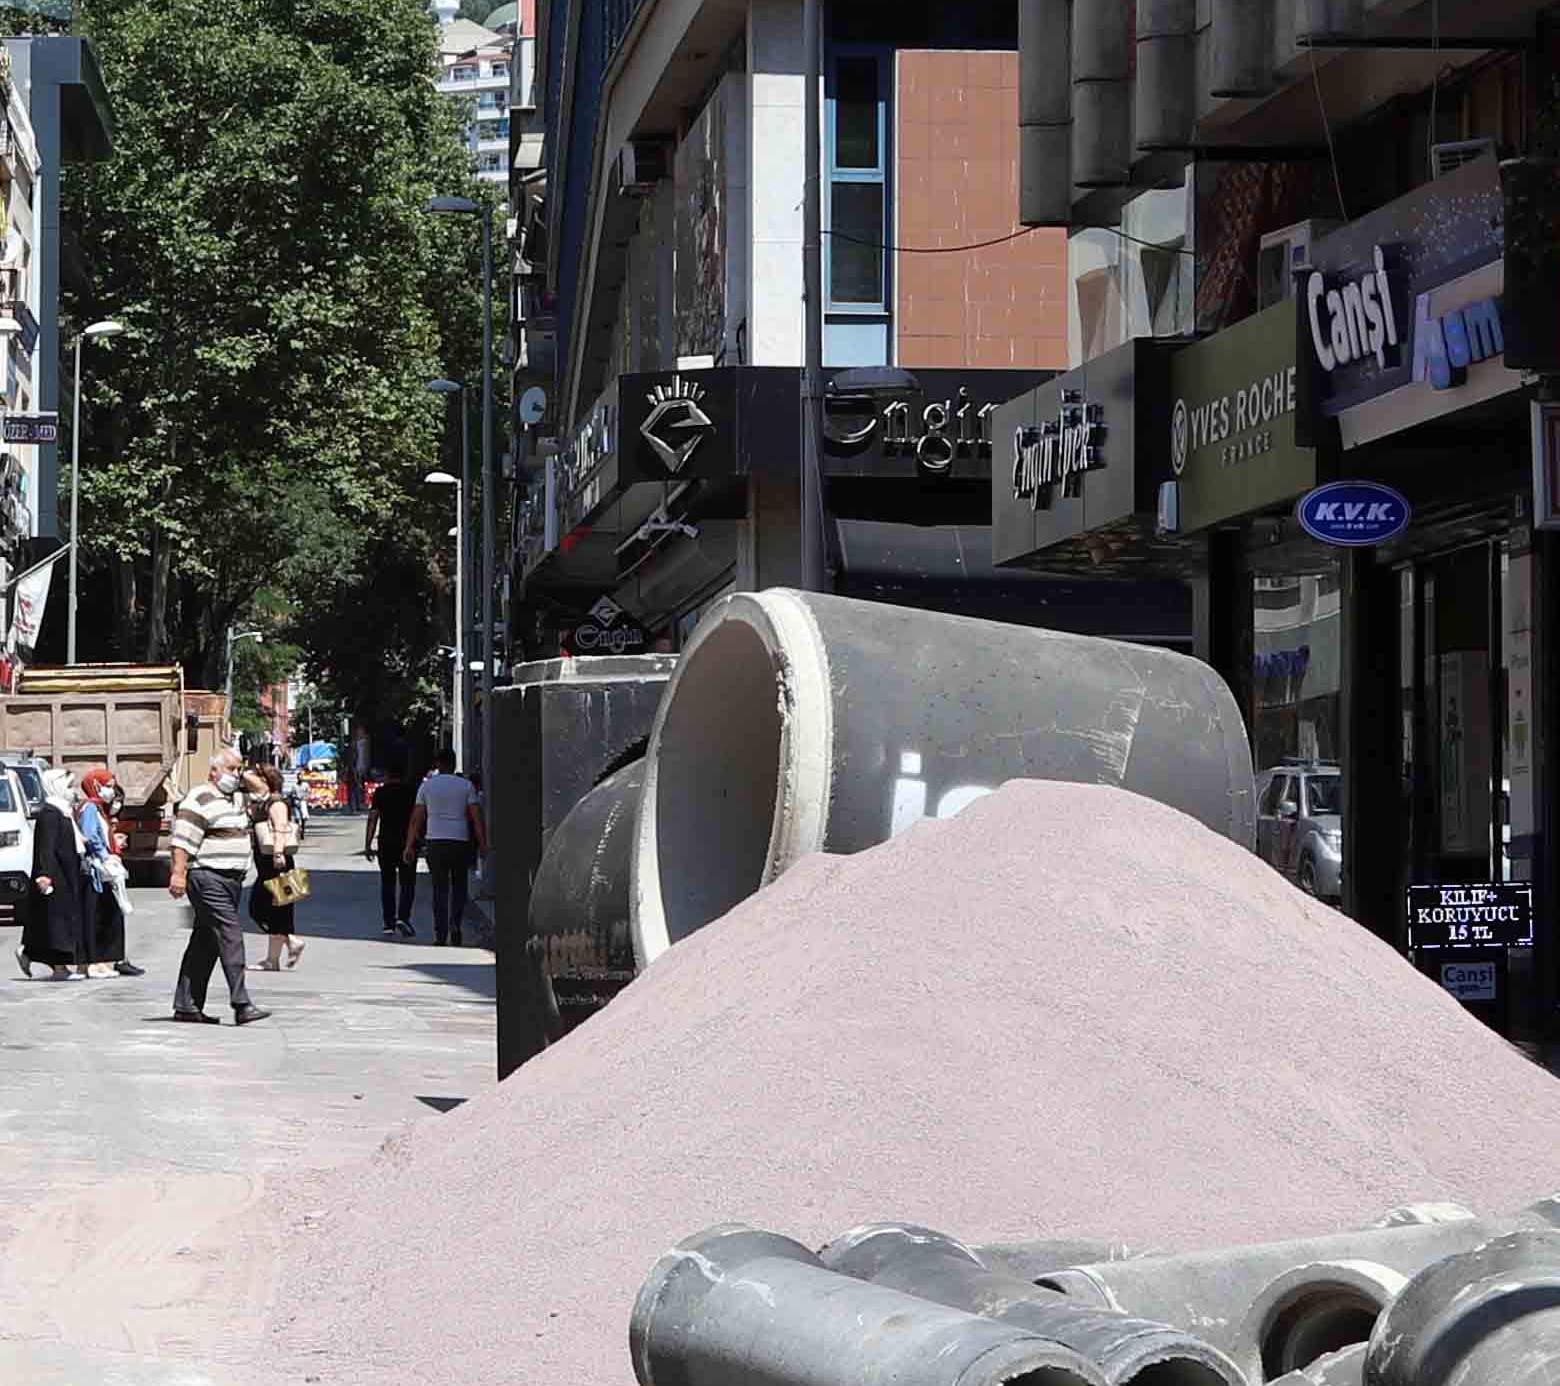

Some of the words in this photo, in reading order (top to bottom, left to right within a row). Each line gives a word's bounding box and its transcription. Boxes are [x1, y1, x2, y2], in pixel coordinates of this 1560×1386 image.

[1190, 406, 1230, 451] YVES
[1235, 366, 1296, 430] ROCHE
[1220, 431, 1272, 467] FRANCE
[1314, 502, 1396, 521] K.V.K.
[1439, 889, 1498, 906] KILIF+
[1416, 905, 1520, 924] KORUYUCU
[1448, 925, 1468, 941] 15
[1471, 925, 1494, 940] TL
